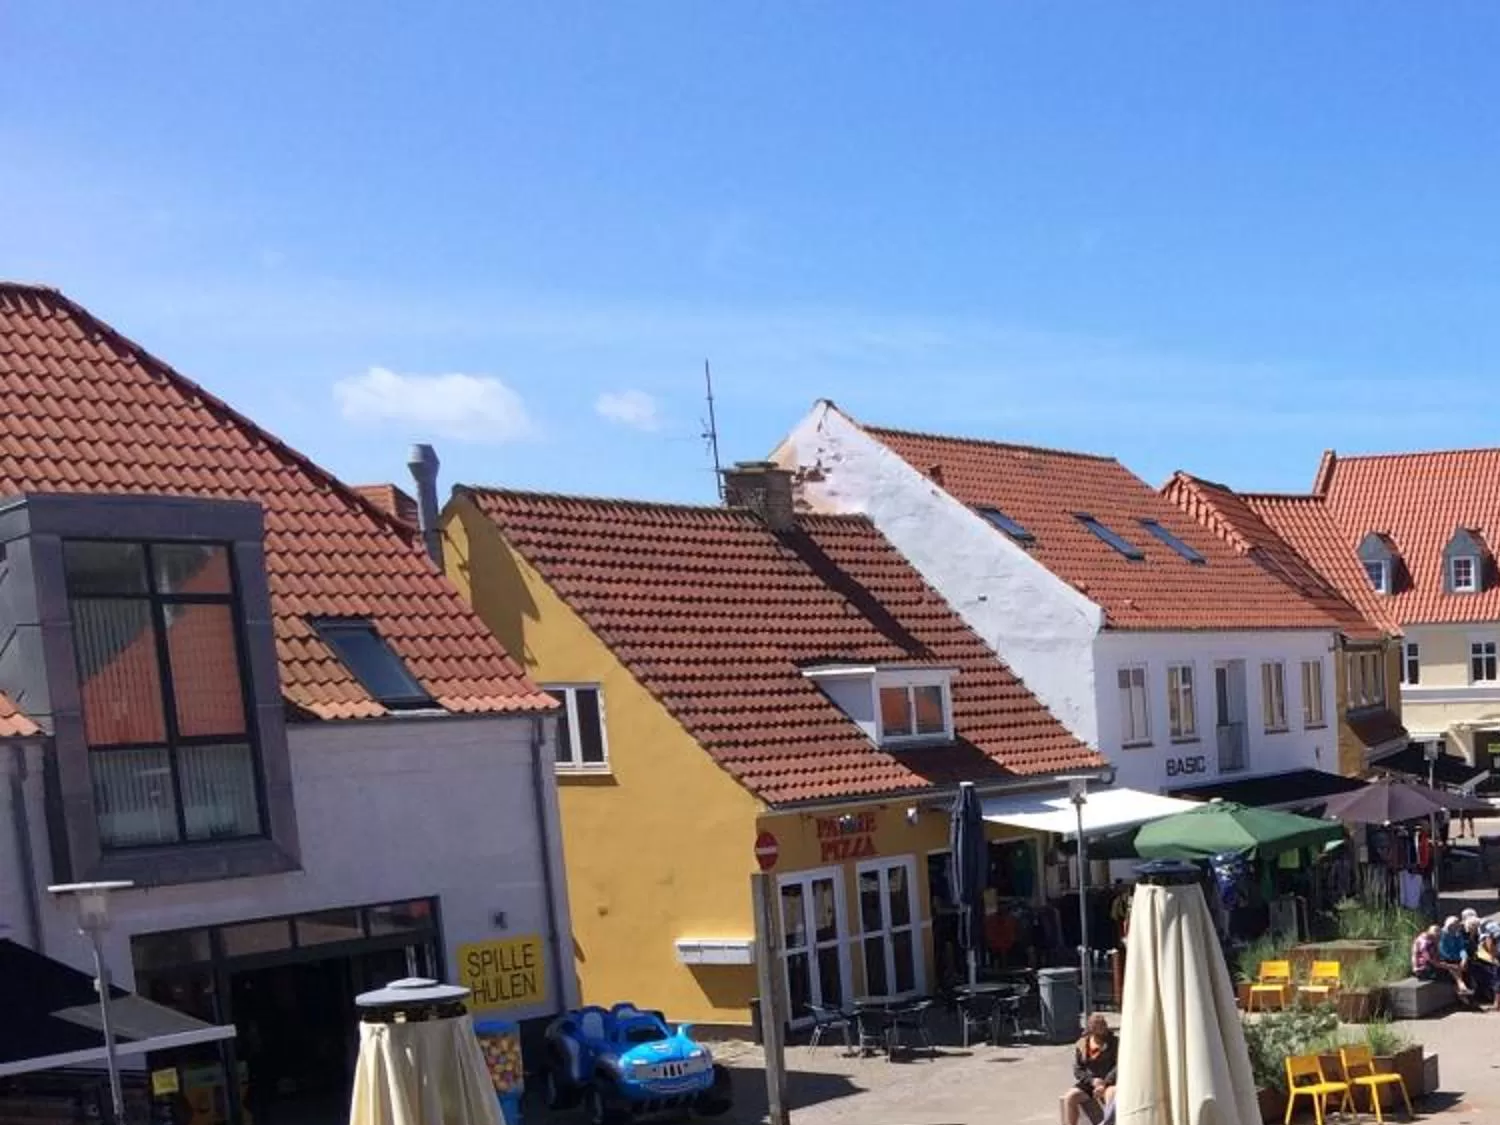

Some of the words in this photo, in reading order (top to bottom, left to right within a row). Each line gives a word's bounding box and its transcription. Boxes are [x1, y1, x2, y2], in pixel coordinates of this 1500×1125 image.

[1166, 755, 1206, 777] BASIC
[467, 943, 535, 977] SPILLE
[471, 972, 537, 1005] HULEN
